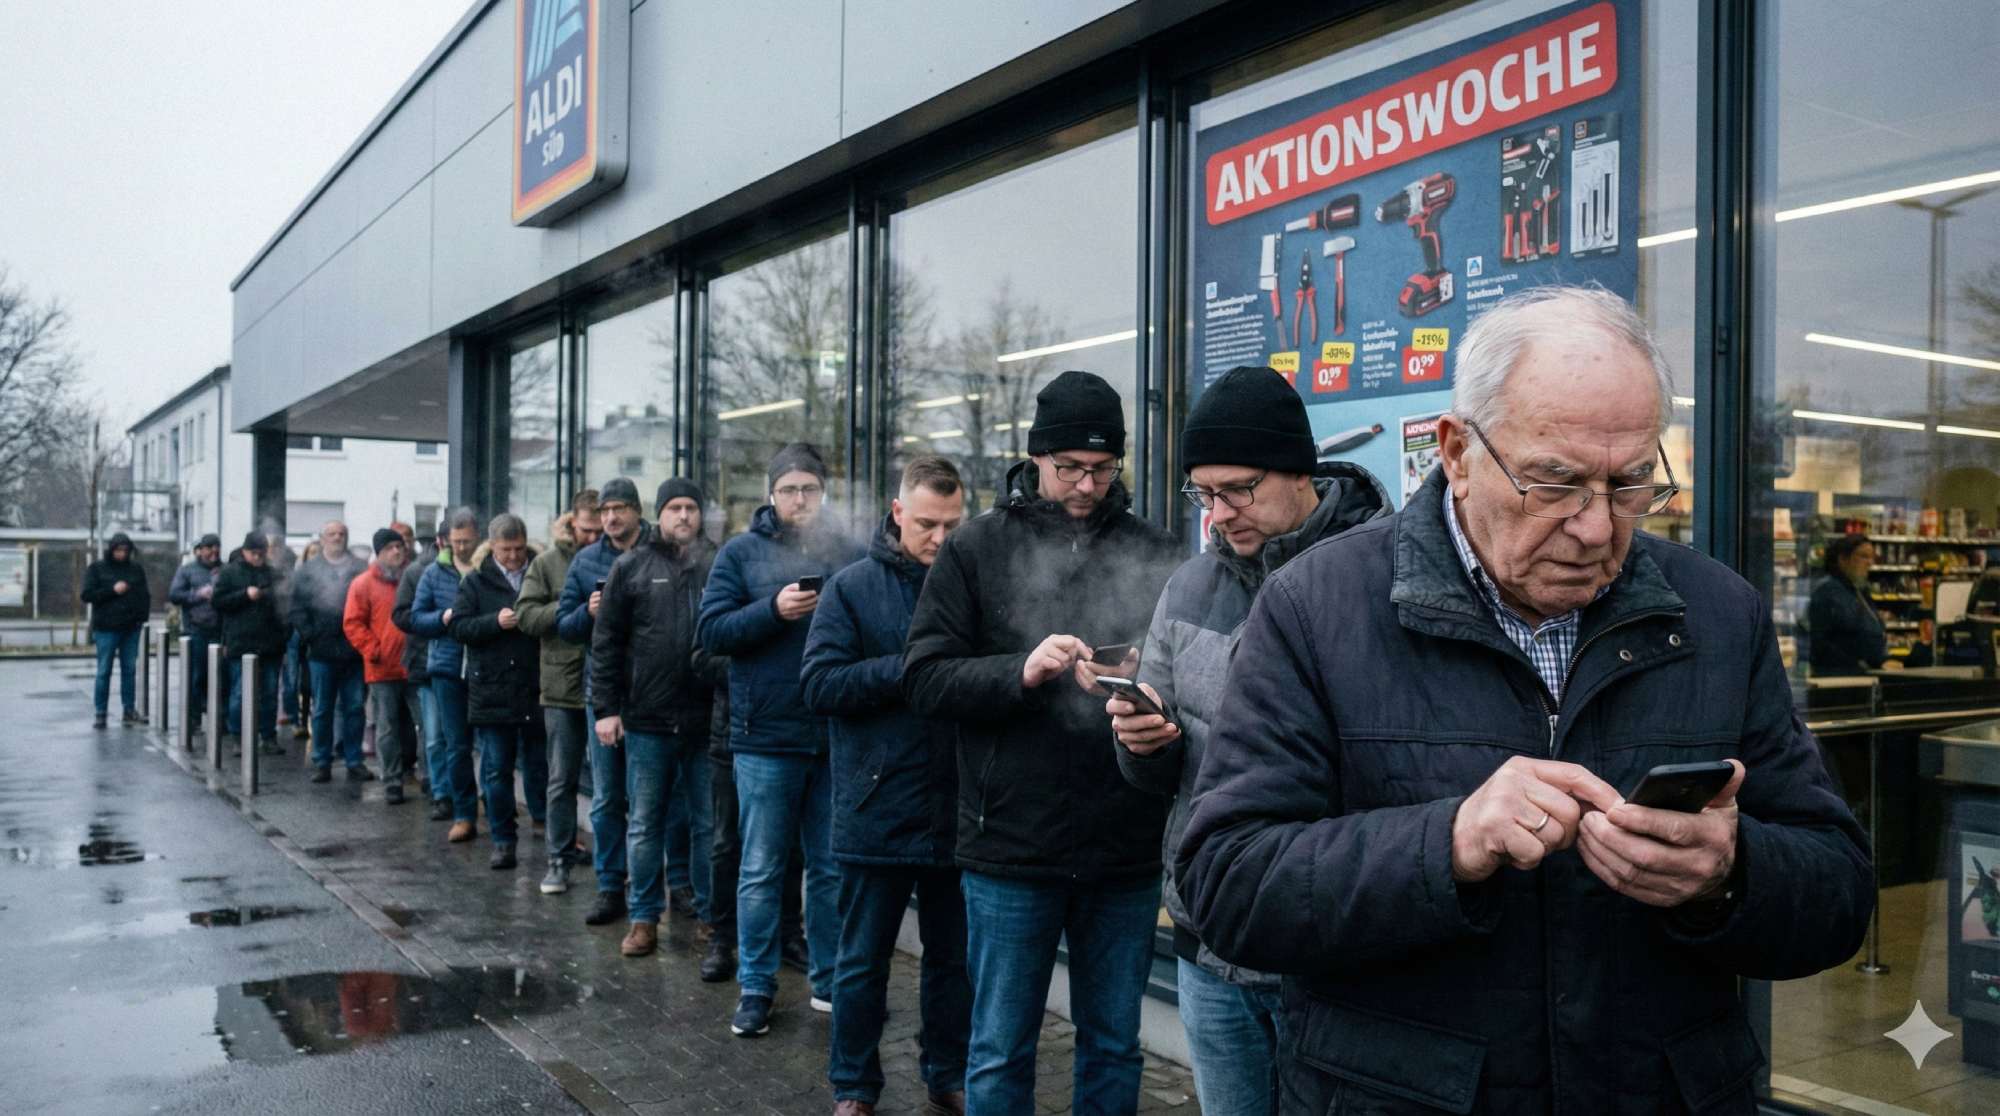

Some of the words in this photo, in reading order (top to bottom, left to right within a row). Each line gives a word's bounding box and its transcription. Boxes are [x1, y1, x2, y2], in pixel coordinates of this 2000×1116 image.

[525, 54, 582, 145] ALDI
[1214, 21, 1602, 212] AKTIONSWOCHE
[542, 129, 565, 167] SÜD
